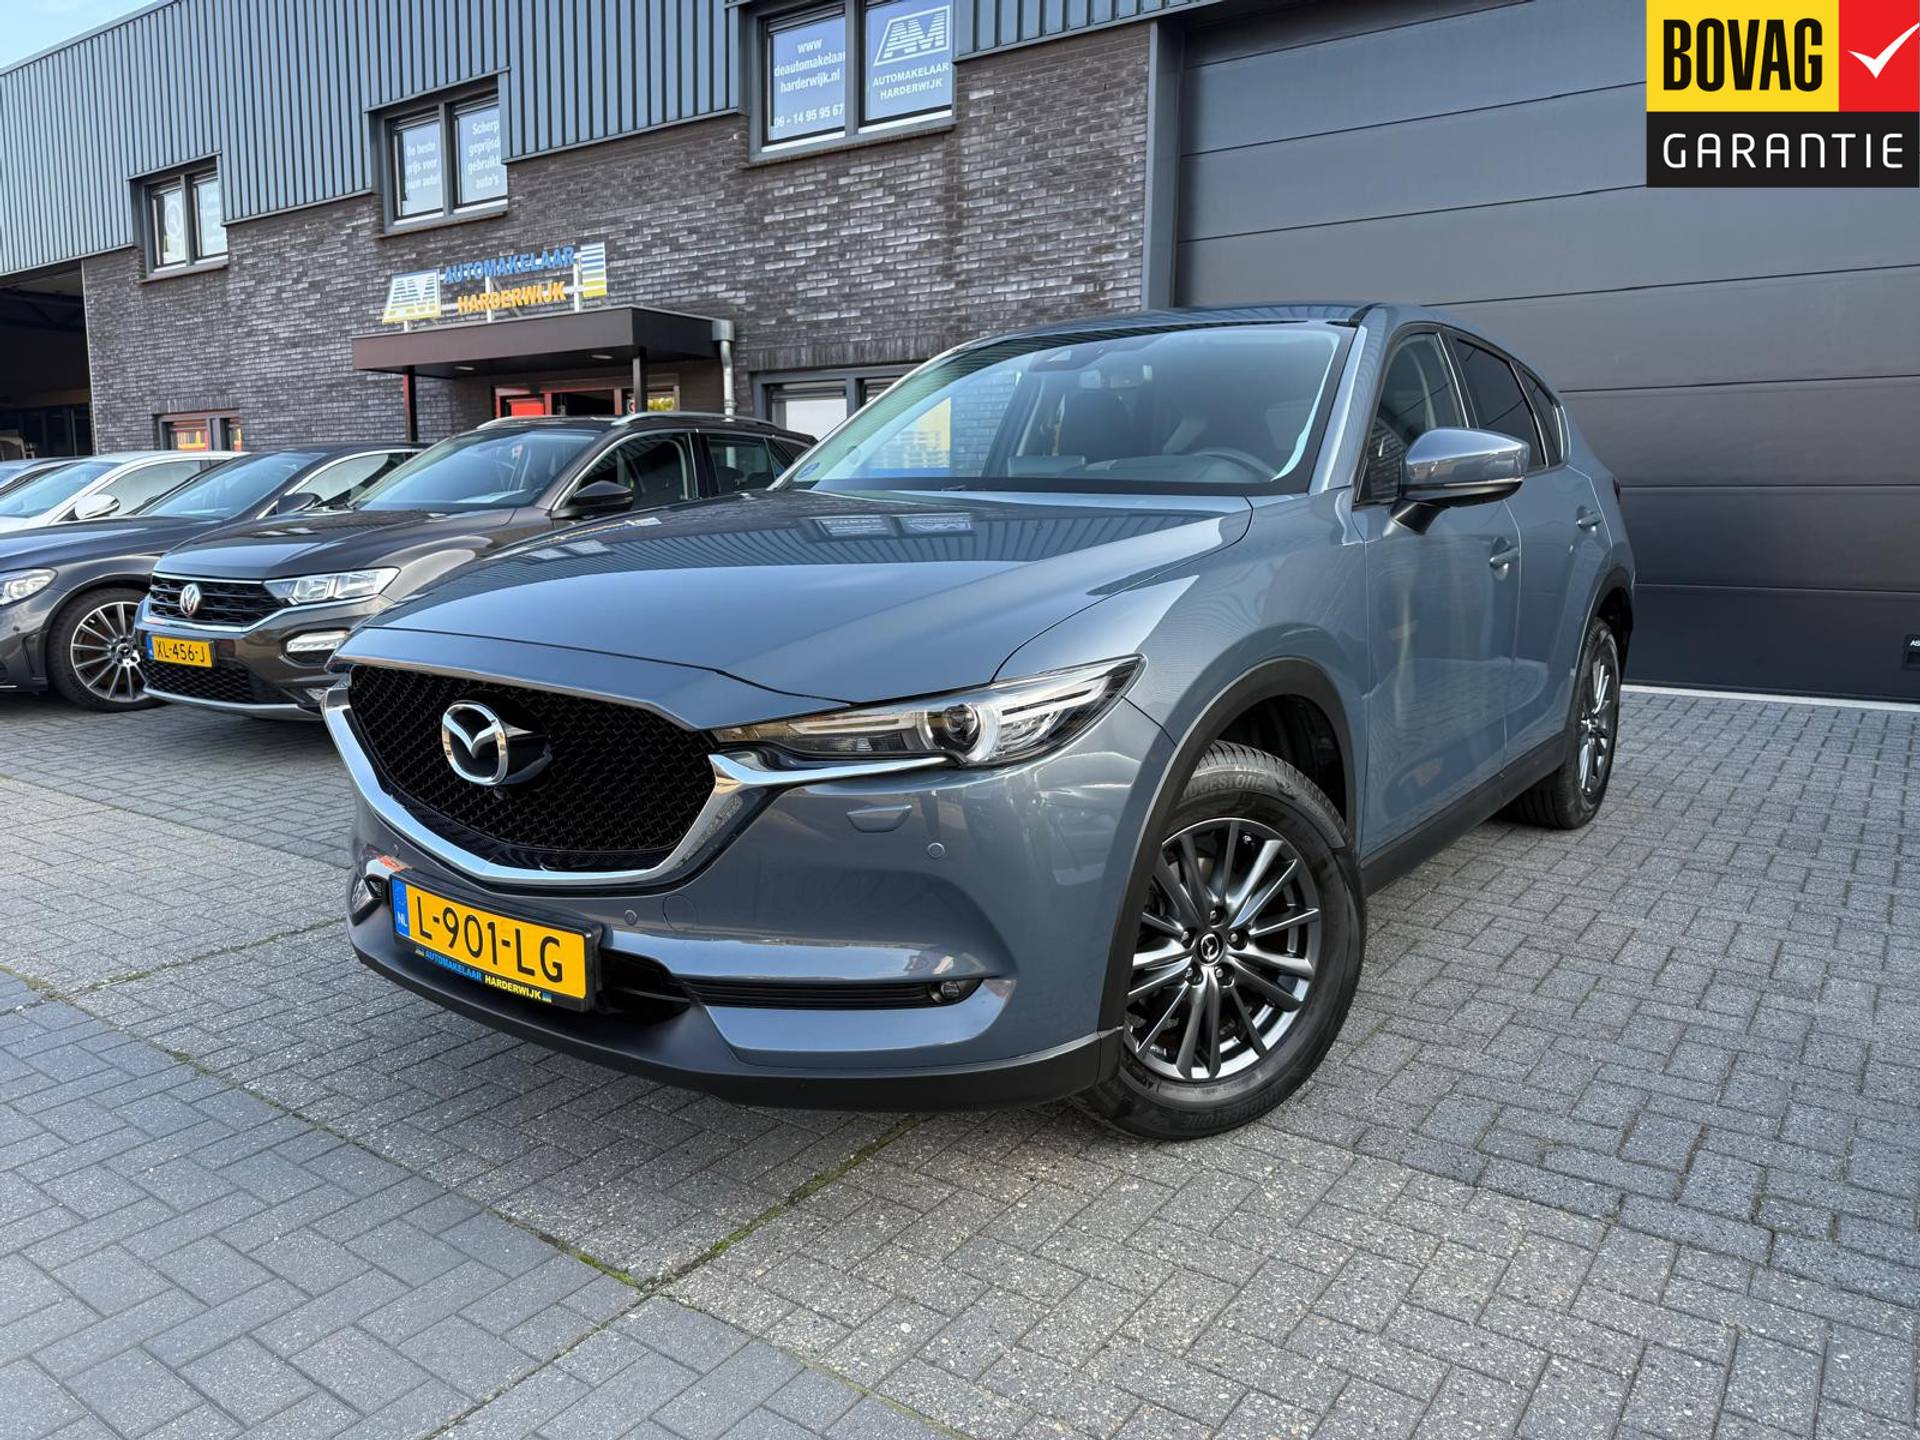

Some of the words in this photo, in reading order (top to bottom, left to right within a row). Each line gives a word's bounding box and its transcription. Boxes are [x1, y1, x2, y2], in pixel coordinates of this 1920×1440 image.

[797, 39, 823, 54] www
[780, 68, 840, 94] harderwijk.nl
[872, 62, 949, 87] AUTOMAKELAAR
[880, 78, 943, 100] HARDERWIJK
[472, 119, 499, 136] Scherp
[793, 111, 804, 124] 14
[443, 246, 577, 285] AUTOMAKELAAR
[457, 280, 567, 315] HARDERWIJK
[154, 638, 205, 663] XL-456-J
[397, 911, 408, 929] NL
[416, 895, 563, 983] L-901-LG
[425, 949, 483, 983] AUTOMAKELAAR
[484, 974, 542, 1001] HARDERWIJK
